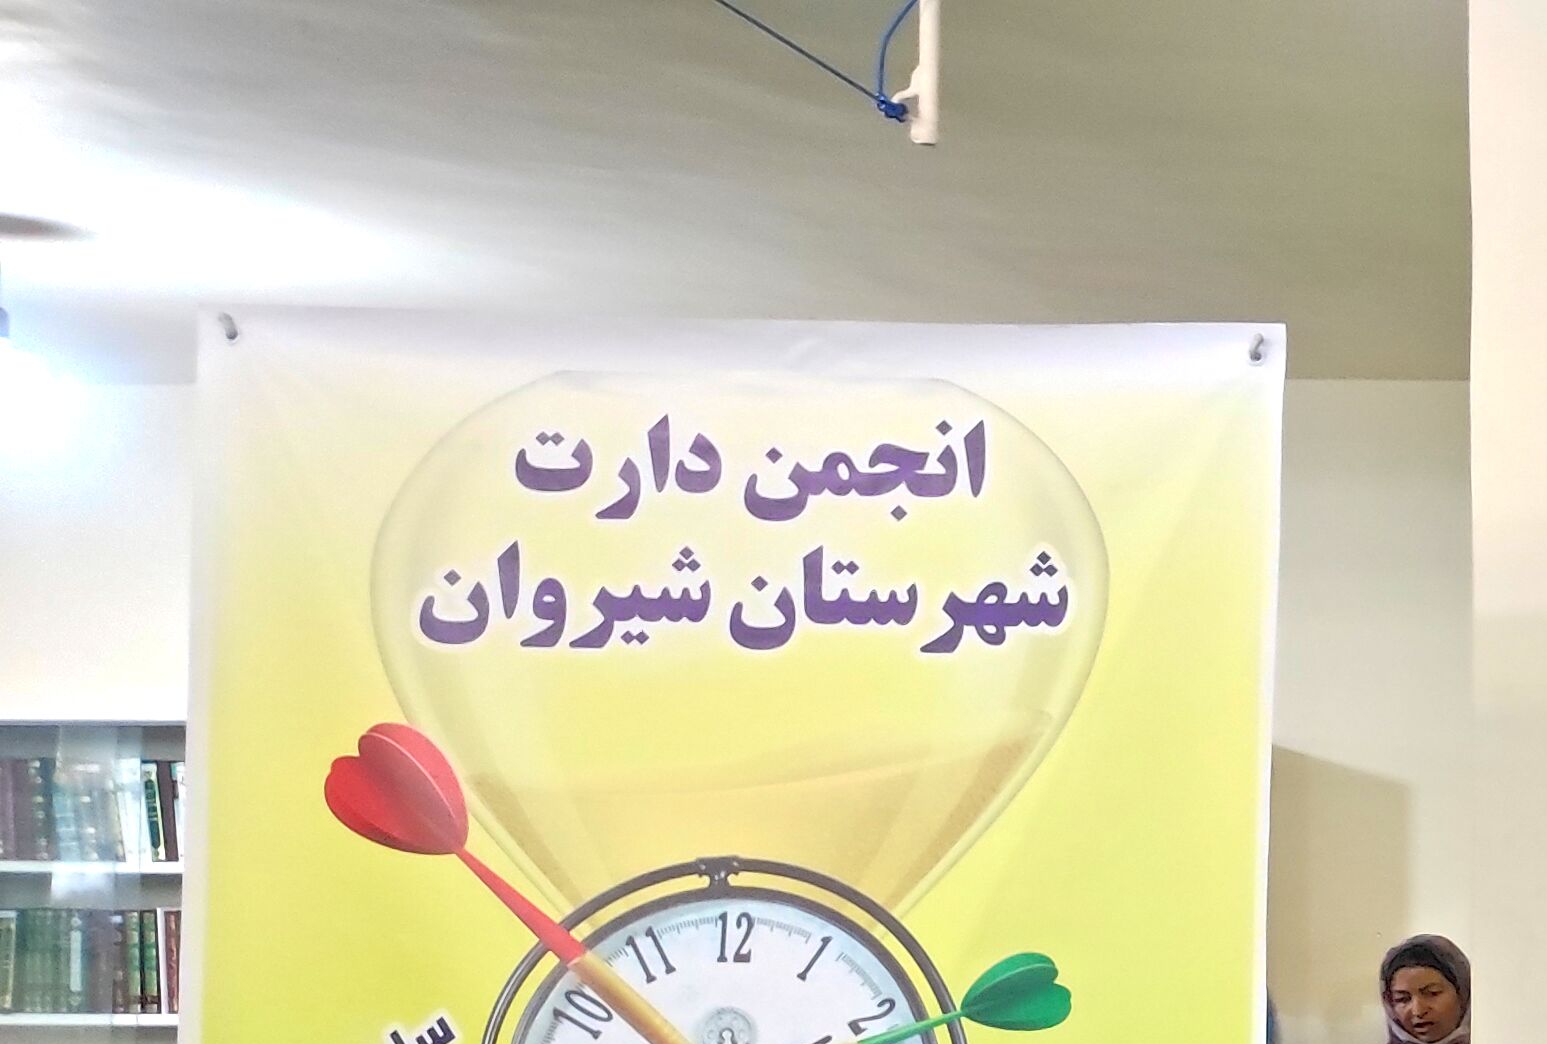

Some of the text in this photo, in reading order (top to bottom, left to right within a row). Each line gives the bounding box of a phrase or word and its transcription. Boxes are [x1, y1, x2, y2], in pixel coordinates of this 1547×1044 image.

[514, 414, 985, 522] انجمن دارت
[417, 542, 1071, 655] شهرستان شیروان
[625, 925, 677, 984] 11
[717, 911, 752, 963] 12
[797, 935, 833, 982] 1
[552, 990, 614, 1041] 10
[848, 998, 896, 1037] 2
